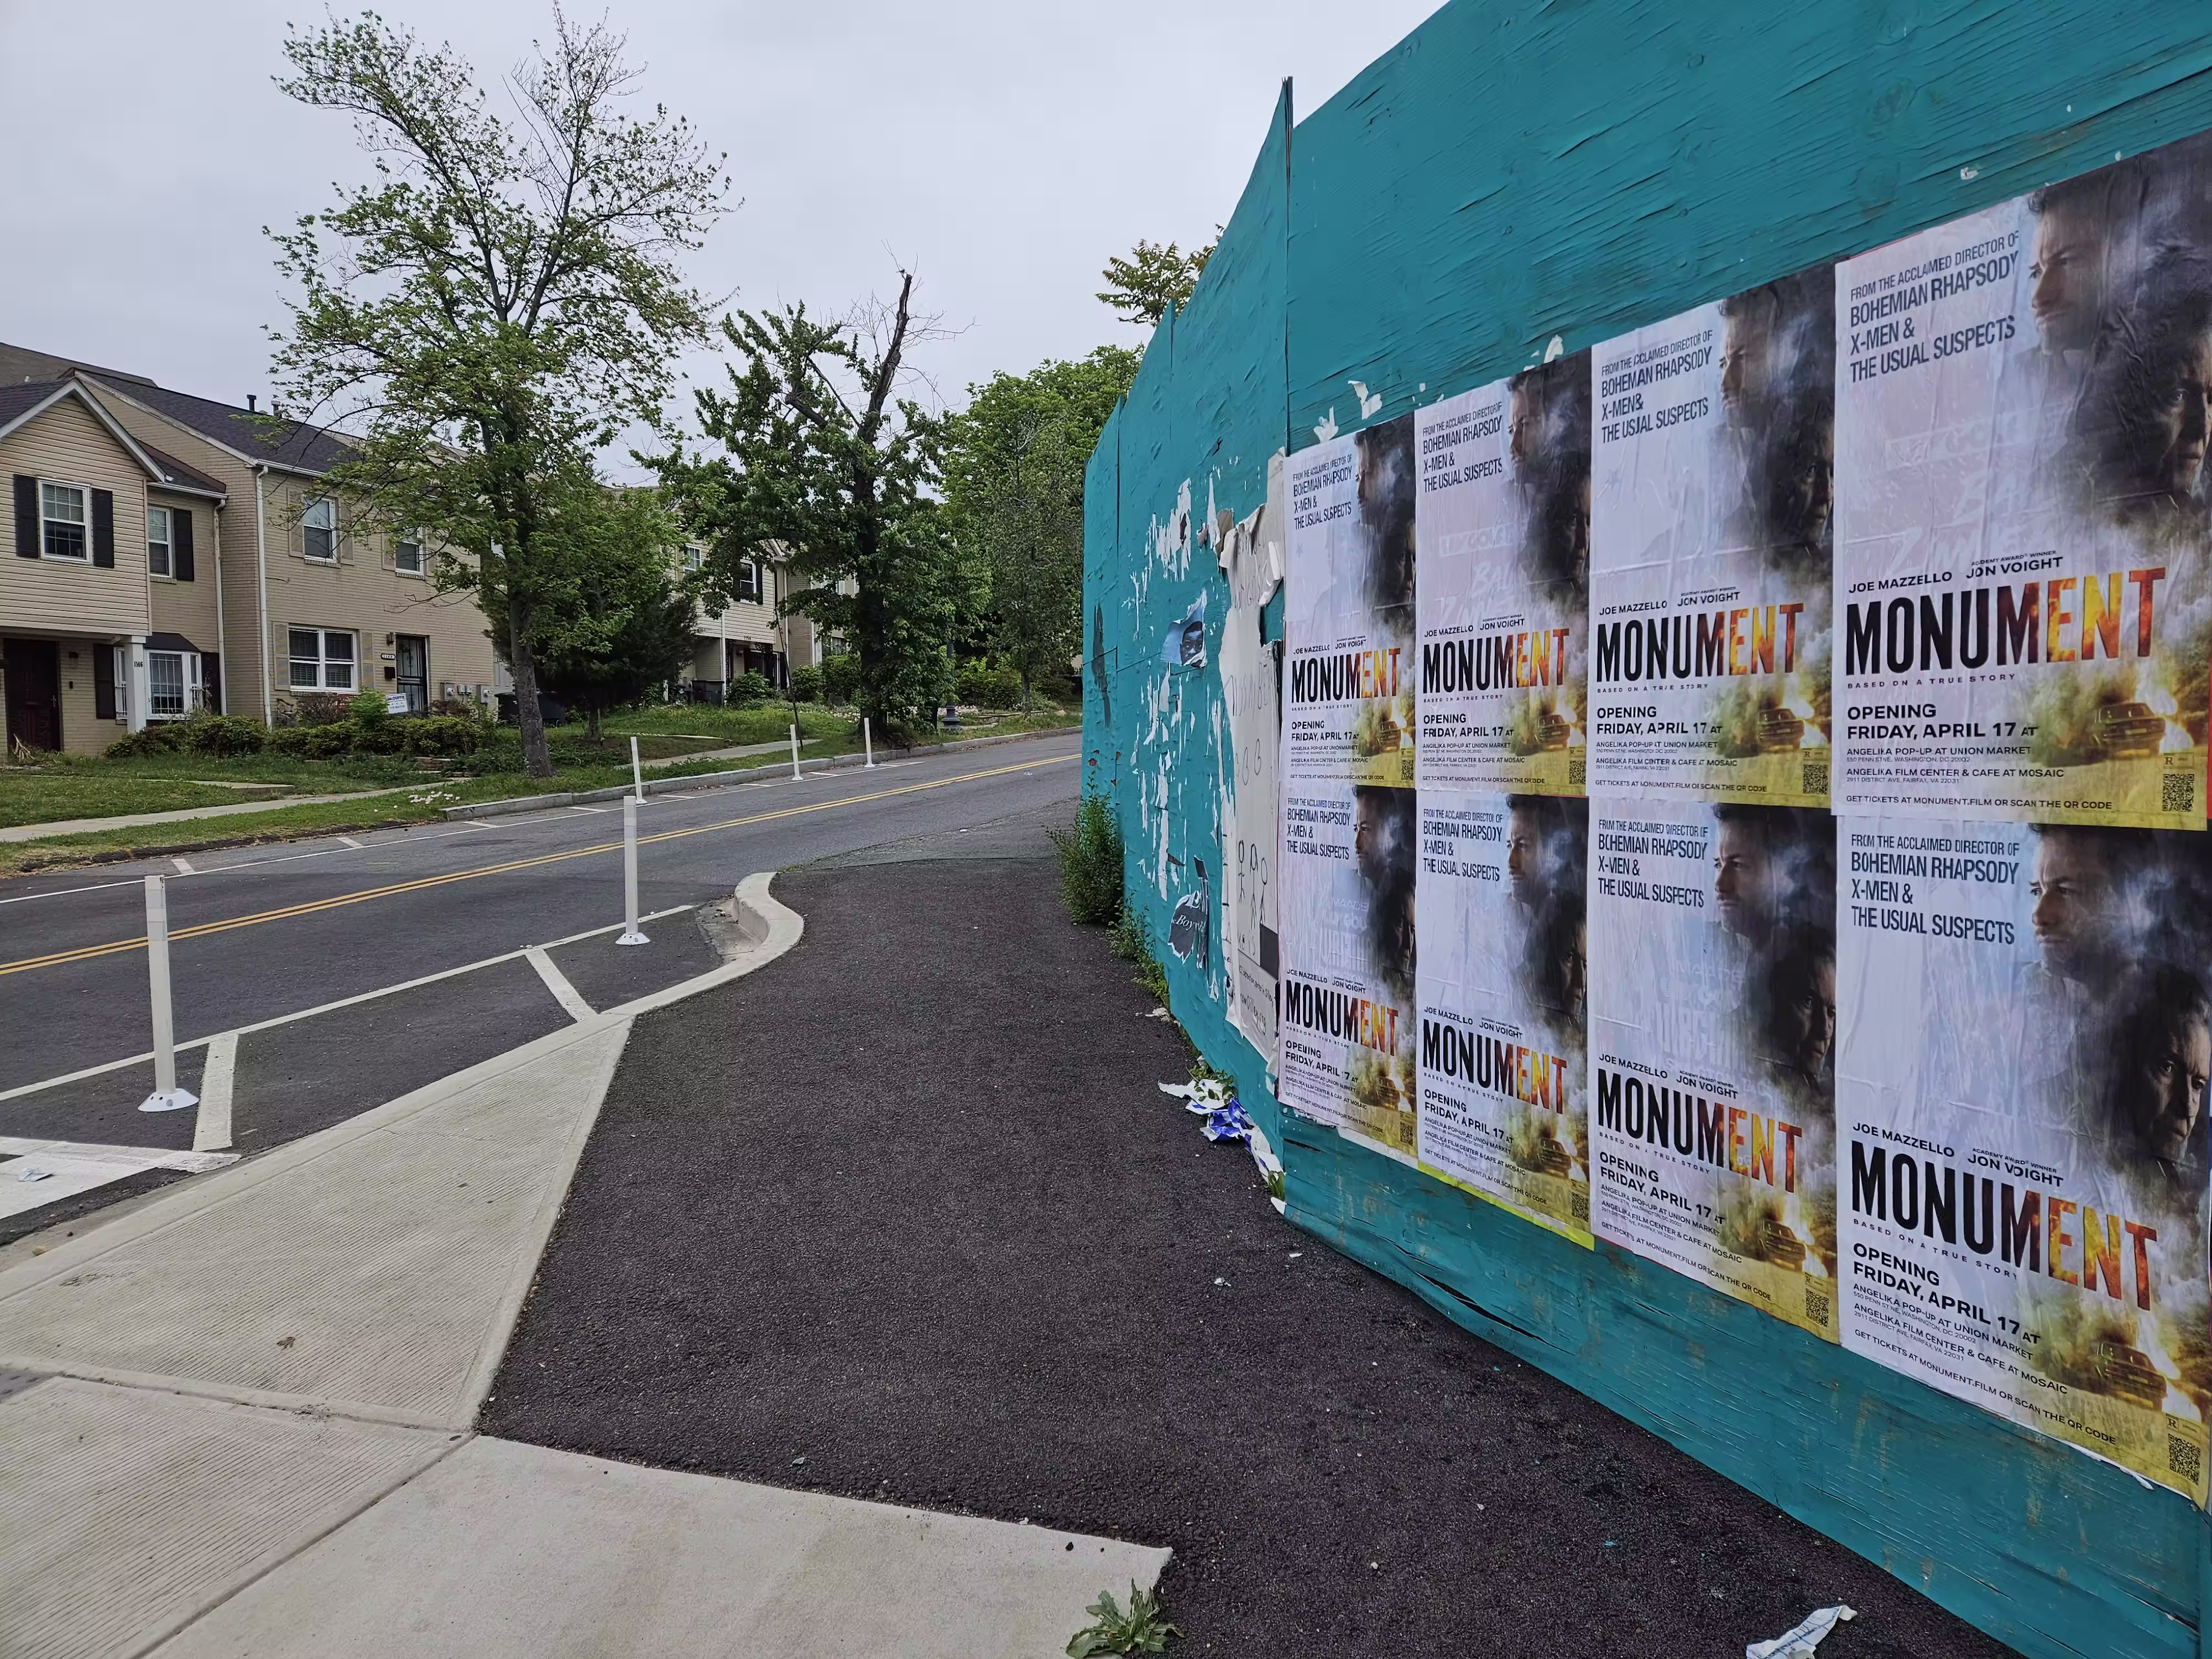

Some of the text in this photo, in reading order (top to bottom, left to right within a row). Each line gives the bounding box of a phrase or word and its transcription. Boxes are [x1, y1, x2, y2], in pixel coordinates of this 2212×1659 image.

[1851, 281, 1875, 301] FROM
[1879, 274, 1895, 292] THE
[1955, 236, 2005, 265] DIRECTOR
[1851, 251, 2018, 327] BOHEMIAN RHAPSODY
[1850, 315, 2015, 383] THE USUAL SUSPECTS
[1851, 317, 1914, 356] X-MEN &
[1849, 571, 1952, 593] JOE MAZZELLO
[1966, 557, 2063, 579] JON VOIGHT
[1599, 601, 1667, 615] JOE MAZZELLO
[1677, 592, 1740, 607] JON VOIGHT
[1424, 625, 1473, 637] JOE MAZZELLO
[1497, 618, 1525, 628] VOIGHT
[1846, 567, 2166, 675] MONUMENT
[1597, 603, 1804, 682] MONUMENT
[1292, 648, 1400, 703] MONUMENT
[1423, 628, 1569, 693] MONUMENT
[1292, 720, 1324, 729] OPENING
[1424, 713, 1466, 723] OPENING
[1597, 706, 1656, 718] OPENING
[1847, 703, 1936, 720] OPENING
[1321, 731, 1342, 740] APRIL
[1344, 731, 1352, 739] 17
[1424, 728, 1458, 738] FRIDAY,
[1460, 727, 1489, 737] APRIL
[1493, 727, 1504, 735] 17
[1597, 723, 1643, 735] FRIDAY,
[1692, 722, 1707, 733] 17
[1848, 722, 2037, 740] FRIDAY, APRIL 17 AT
[1877, 836, 1894, 848] THE
[1897, 837, 1952, 851] ACCLAIMED
[1955, 840, 2004, 854] DIRECTOR
[2008, 843, 2020, 855] OF
[1851, 852, 2020, 884] BOHEMIAN RHAPSODY
[1598, 878, 1704, 907] THE USUAL SUSPECTS
[1851, 879, 1913, 903] X-MEN &
[1851, 906, 2015, 944] THE USUAL SUSPECTS
[1286, 979, 1398, 1056] MONUMENT
[1479, 1021, 1522, 1040] JON VOIGHT
[1316, 1063, 1340, 1077] APRIL
[1423, 1019, 1567, 1114] MONUMENT
[1599, 1053, 1667, 1078] JOE MAZZELLO
[1425, 1089, 1467, 1112] OPENING
[1677, 1076, 1738, 1099] JON VOIGHT
[1425, 1102, 1513, 1144] FRIDAY, APRIL 17 AT
[1598, 1068, 1802, 1193] MONUMENT
[1853, 1121, 1954, 1157] JOE MAZZELLO
[1600, 1151, 1659, 1182] OPENING
[1967, 1152, 2000, 1170] JON
[1973, 1147, 2003, 1159] ACADEMY
[2031, 1163, 2057, 1173] WINNER
[1601, 1166, 1711, 1218] FRIDAY, APRIL 17
[1851, 1140, 2157, 1313] MONUMENT
[1854, 1218, 1891, 1236] BASED
[1899, 1234, 1914, 1244] ON
[1933, 1246, 1967, 1263] TRUE
[1853, 1241, 1939, 1286] OPENING
[1854, 1261, 2041, 1346] FRIDAY, APRIL 17 AT
[1853, 1282, 2033, 1361] ANGELIKA POP-UP AT UNION MARKET
[1865, 1296, 1880, 1306] PENN
[1943, 1328, 1953, 1337] DC
[1955, 1331, 1976, 1345] 20002
[1854, 1311, 1867, 1320] 2911
[1869, 1317, 1895, 1331] DISTRICT
[1944, 1349, 1964, 1362] 22031
[1854, 1302, 2067, 1396] ANGELIKA FILM CENTER & CAFE AT MOSAIC
[1855, 1328, 2116, 1444] GET TICKETS AT MONUMENT.FILM OR SCAN THE QR CODE
[2167, 1417, 2178, 1430] R
